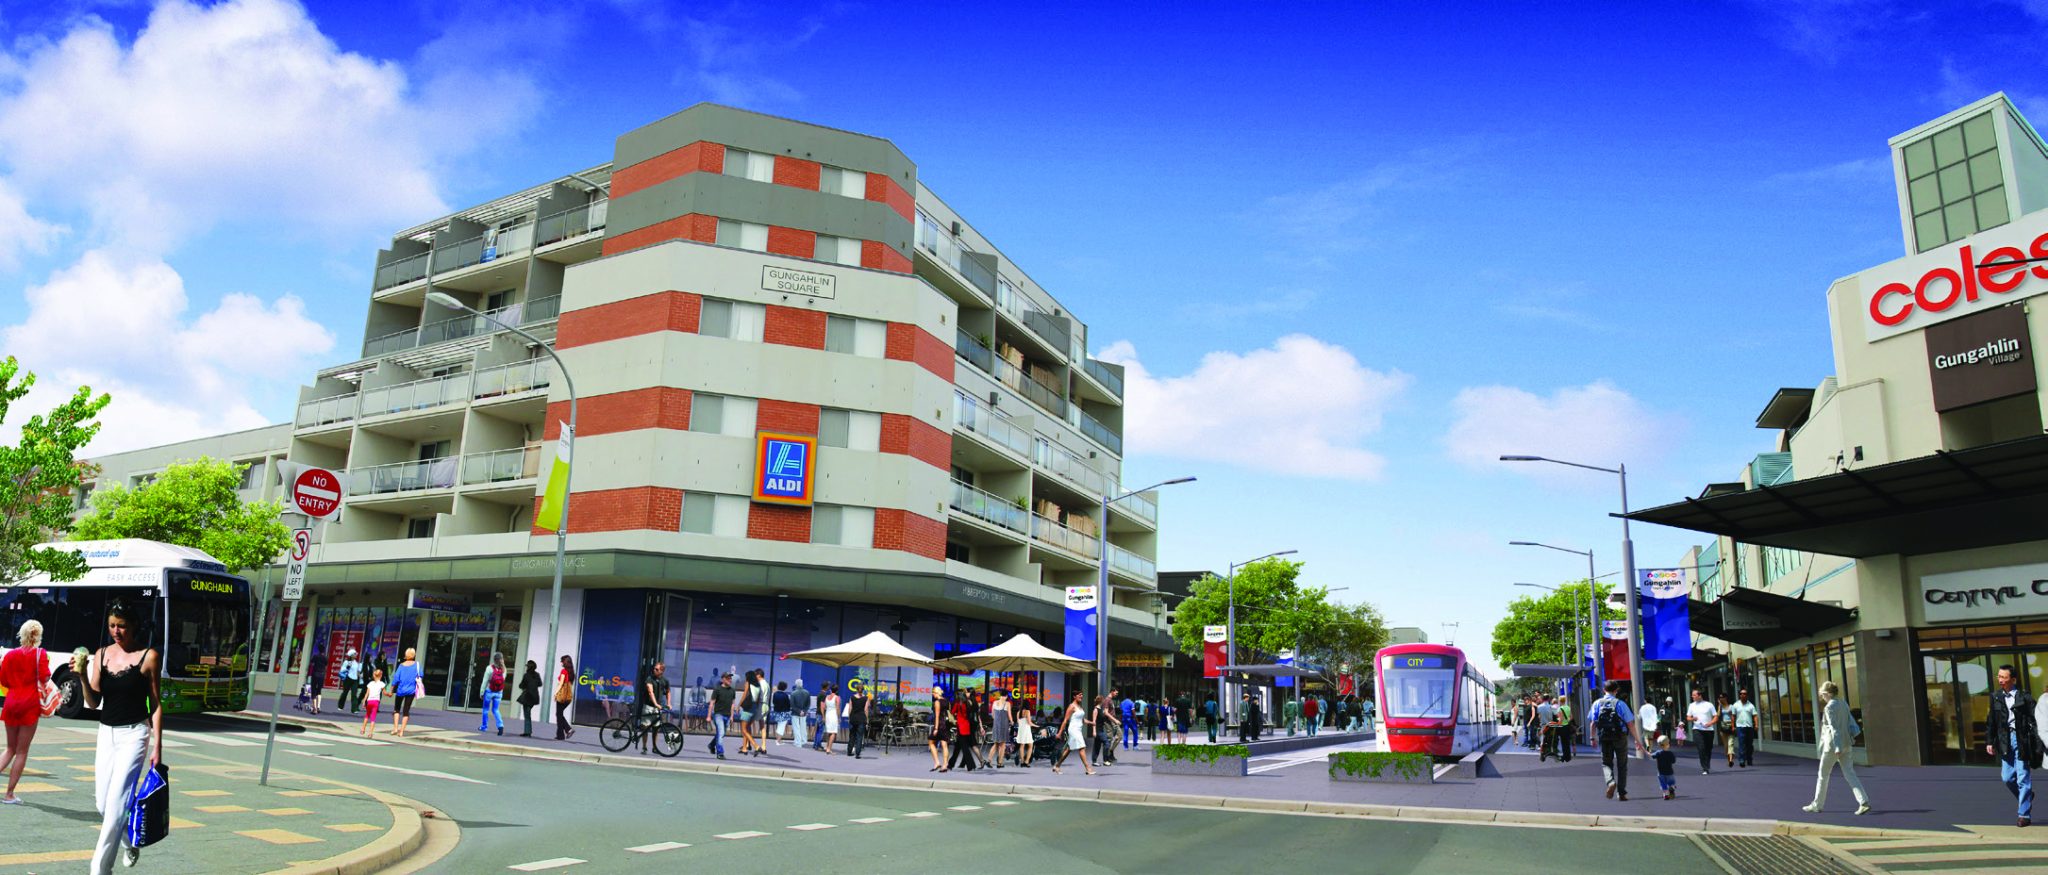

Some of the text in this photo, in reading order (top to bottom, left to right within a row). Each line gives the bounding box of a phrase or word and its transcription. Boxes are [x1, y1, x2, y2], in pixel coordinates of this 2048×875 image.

[769, 270, 830, 286] GUNGAHLIN
[777, 280, 820, 294] SQUARE
[1935, 337, 2020, 369] Gungahlin
[1988, 352, 2021, 365] Village
[312, 476, 327, 487] NO
[766, 478, 802, 492] ALDI
[299, 496, 332, 511] ENTRY
[290, 565, 302, 575] NO
[107, 573, 156, 582] EASY ACCESS
[288, 577, 302, 586] LEFT
[191, 580, 233, 594] GUNGHALIN
[285, 588, 300, 596] TURN
[1407, 658, 1425, 667] CITY
[847, 678, 889, 692] GNGER
